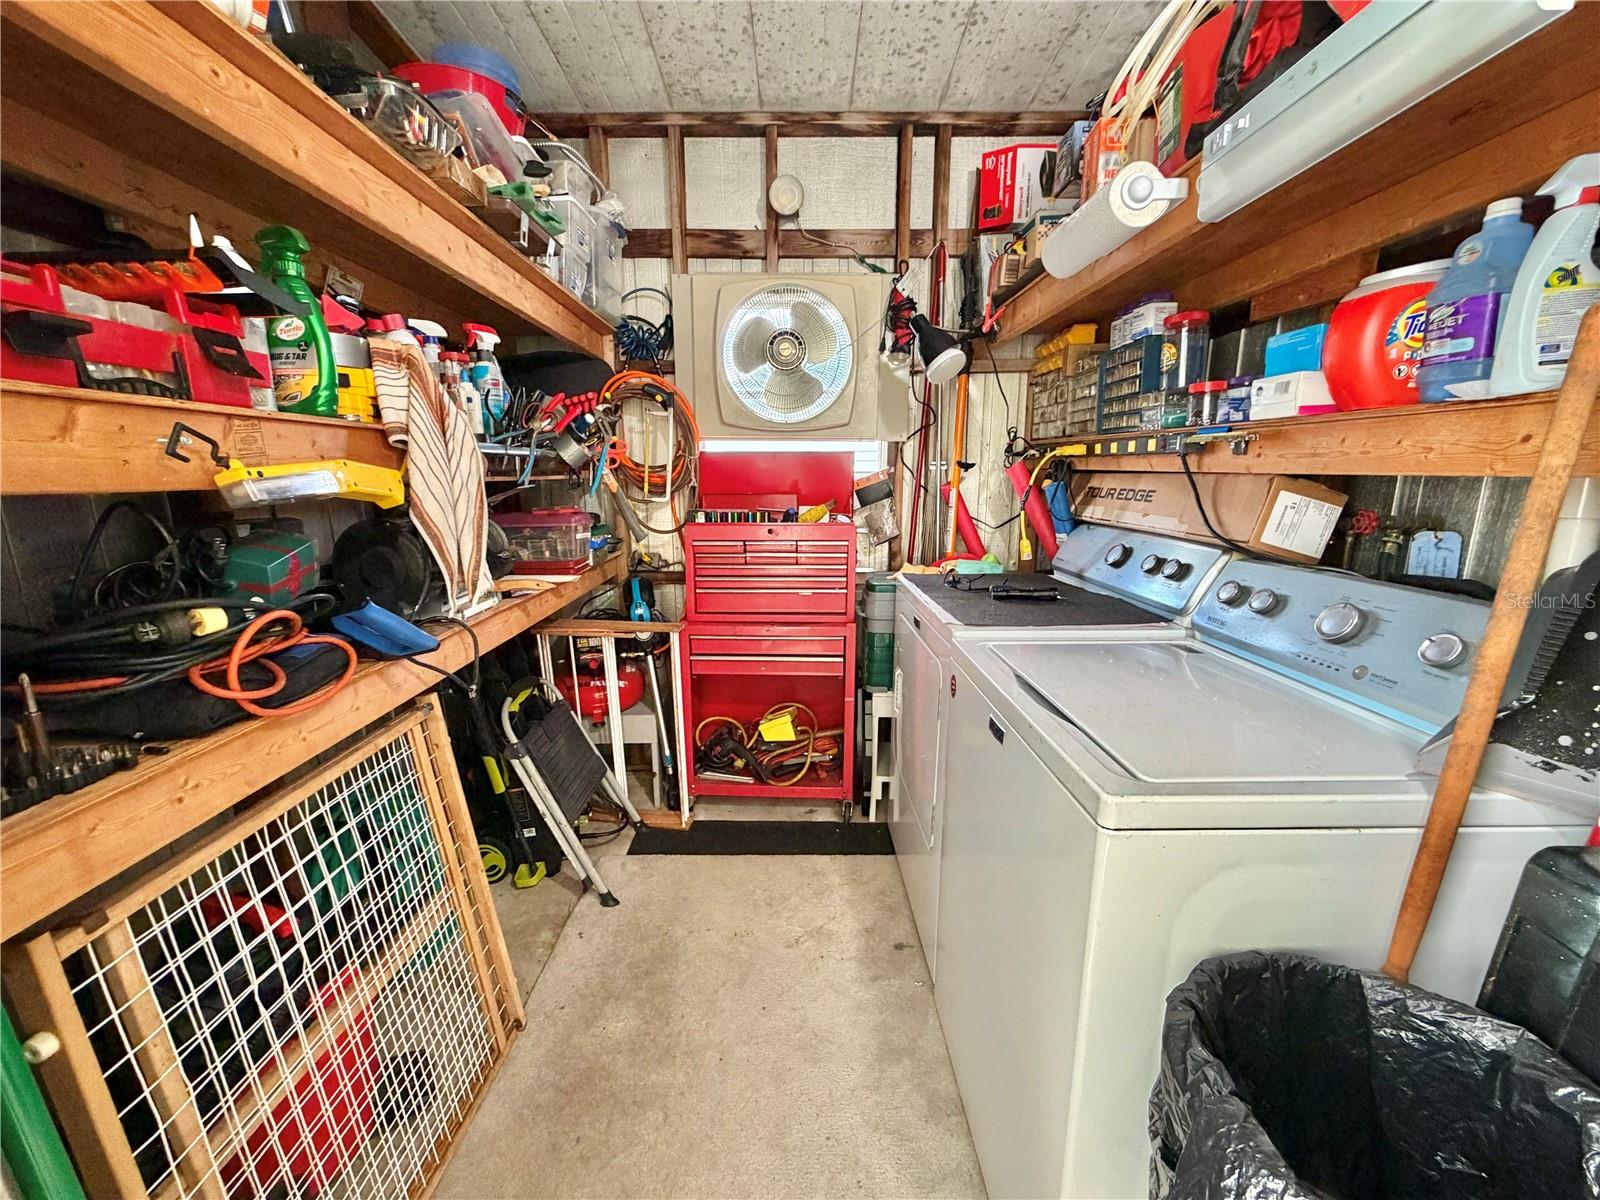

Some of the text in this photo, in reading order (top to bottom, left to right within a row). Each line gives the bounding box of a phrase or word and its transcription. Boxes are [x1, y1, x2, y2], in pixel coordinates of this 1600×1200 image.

[279, 325, 303, 335] Turtle
[292, 352, 307, 361] TAR
[1087, 486, 1157, 503] TOUR EDGE
